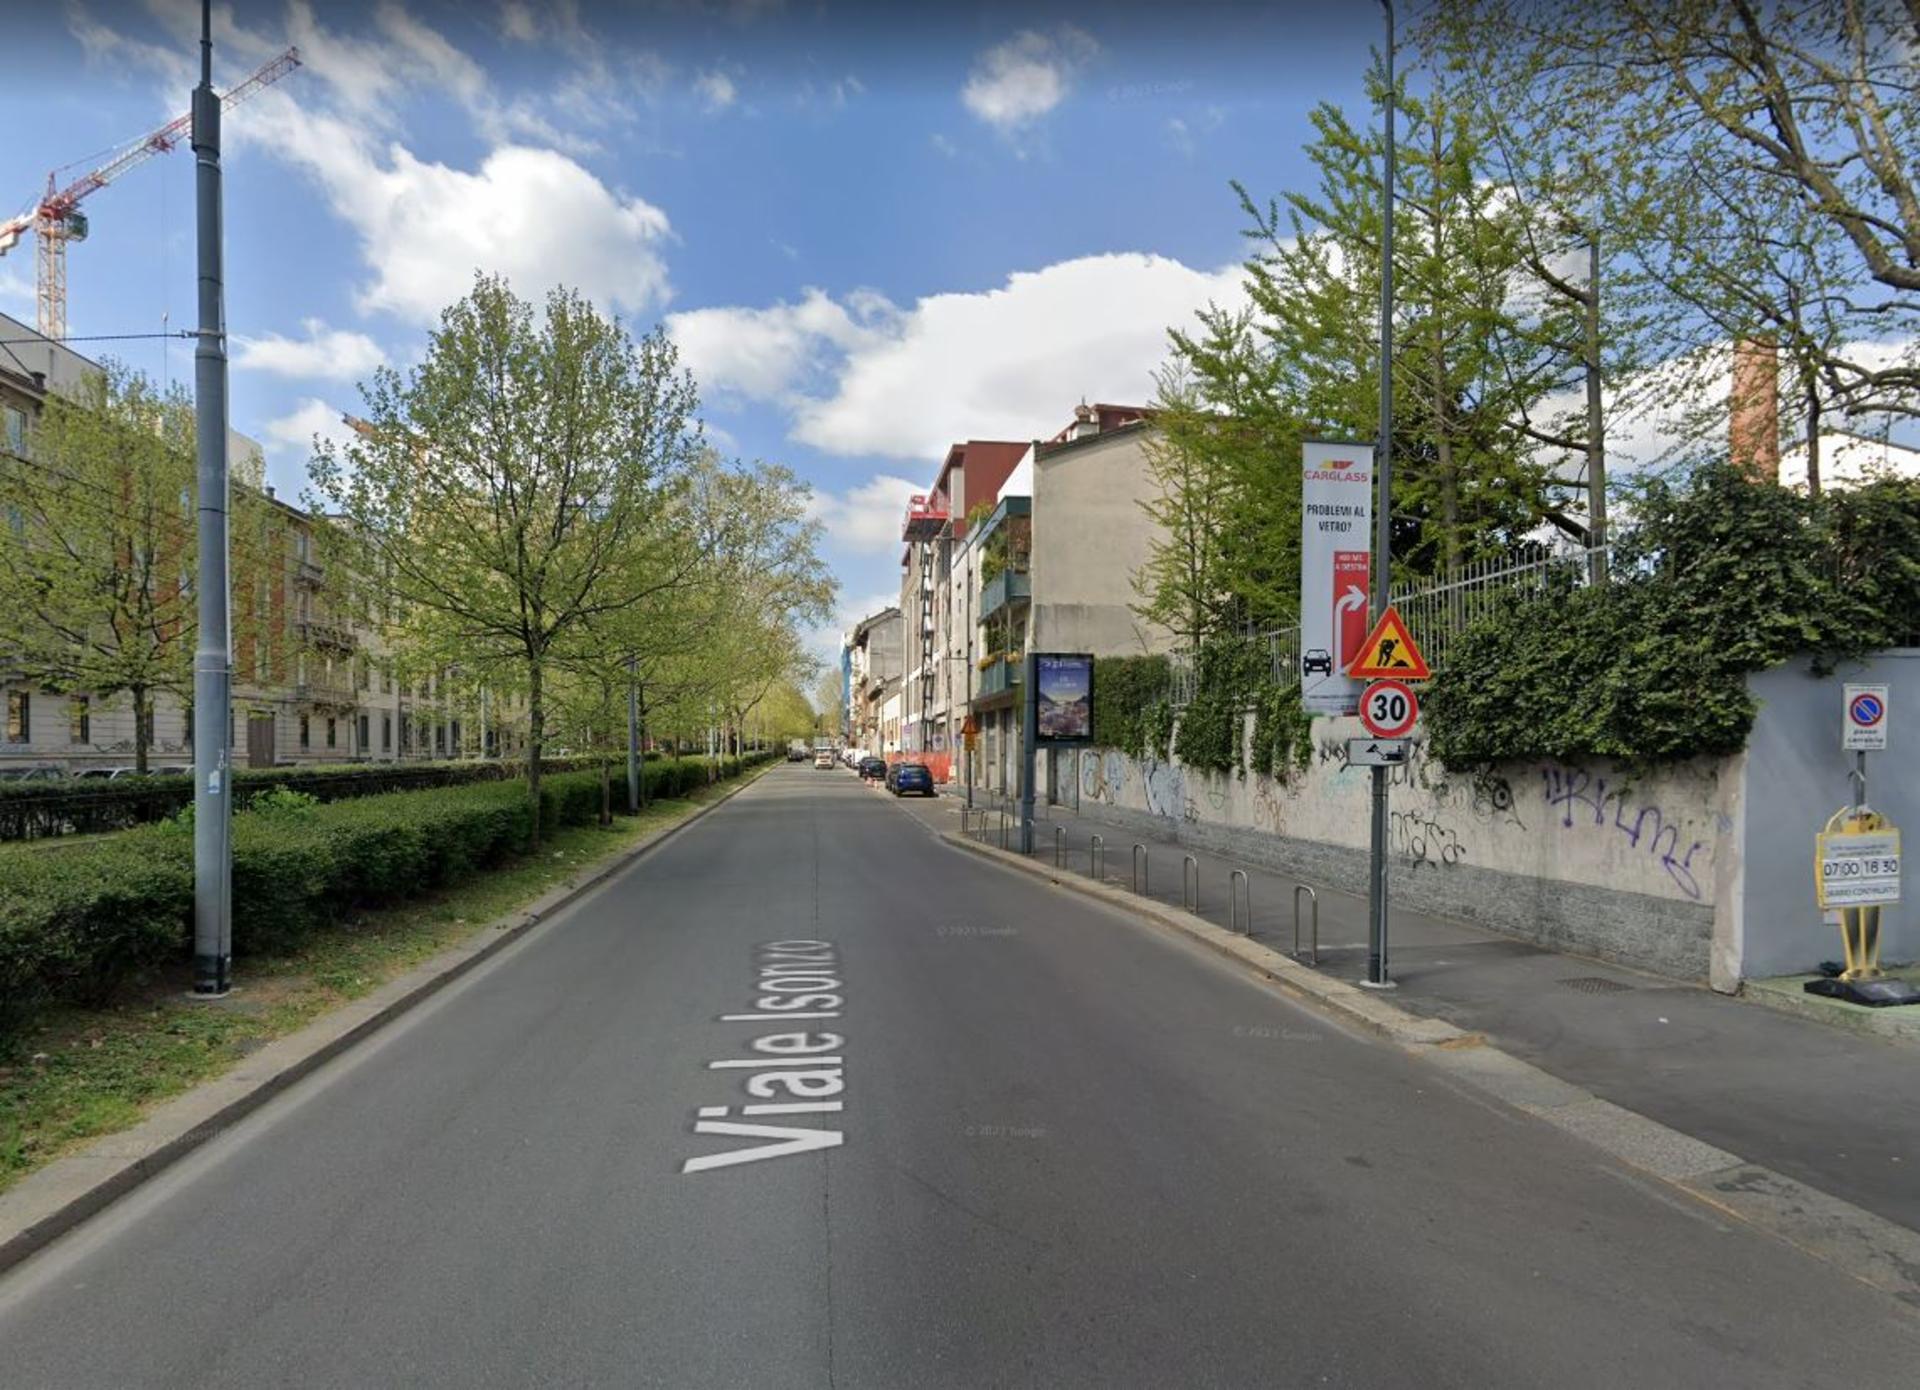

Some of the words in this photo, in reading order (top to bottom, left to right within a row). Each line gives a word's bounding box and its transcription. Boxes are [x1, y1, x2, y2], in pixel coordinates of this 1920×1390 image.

[1304, 470, 1368, 482] CARGLASS
[1307, 504, 1352, 517] PROBLEMI
[1354, 506, 1366, 517] AL
[1319, 521, 1352, 533] VETRO?
[1373, 694, 1406, 722] 30
